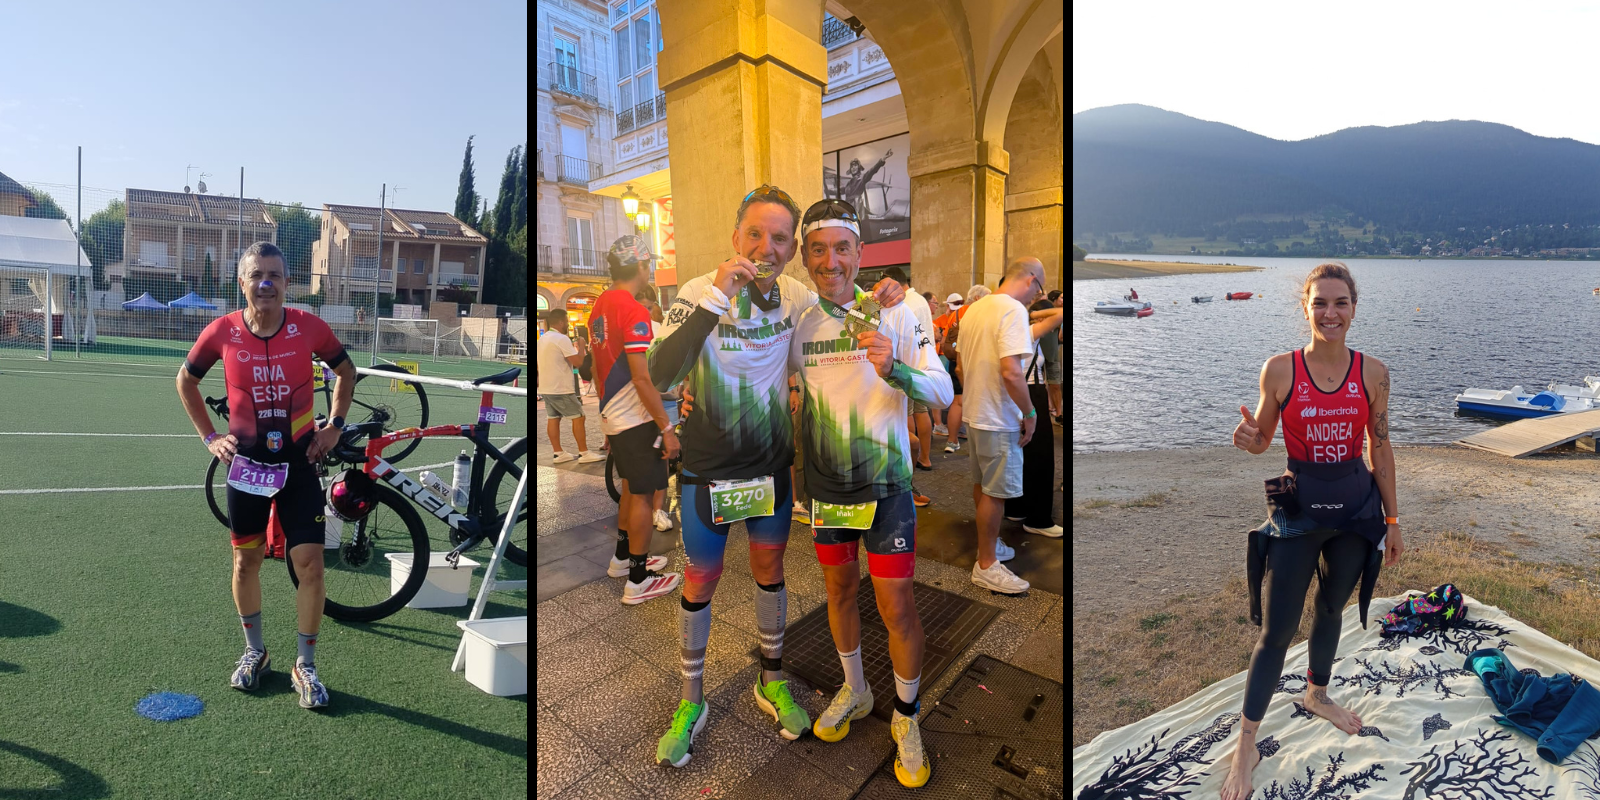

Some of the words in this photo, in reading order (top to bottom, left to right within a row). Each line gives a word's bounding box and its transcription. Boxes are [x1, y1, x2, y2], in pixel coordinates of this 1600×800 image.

[718, 315, 794, 340] IRONMAN
[802, 337, 868, 355] IRONMA
[253, 364, 286, 382] RIVA
[252, 385, 291, 403] ESP
[487, 412, 505, 422] 2115
[1318, 406, 1358, 416] Iberdrola
[1306, 422, 1352, 442] ANDREA
[1313, 444, 1348, 463] ESP
[241, 469, 276, 484] 2118
[372, 454, 470, 530] TREK
[721, 488, 765, 507] 3270
